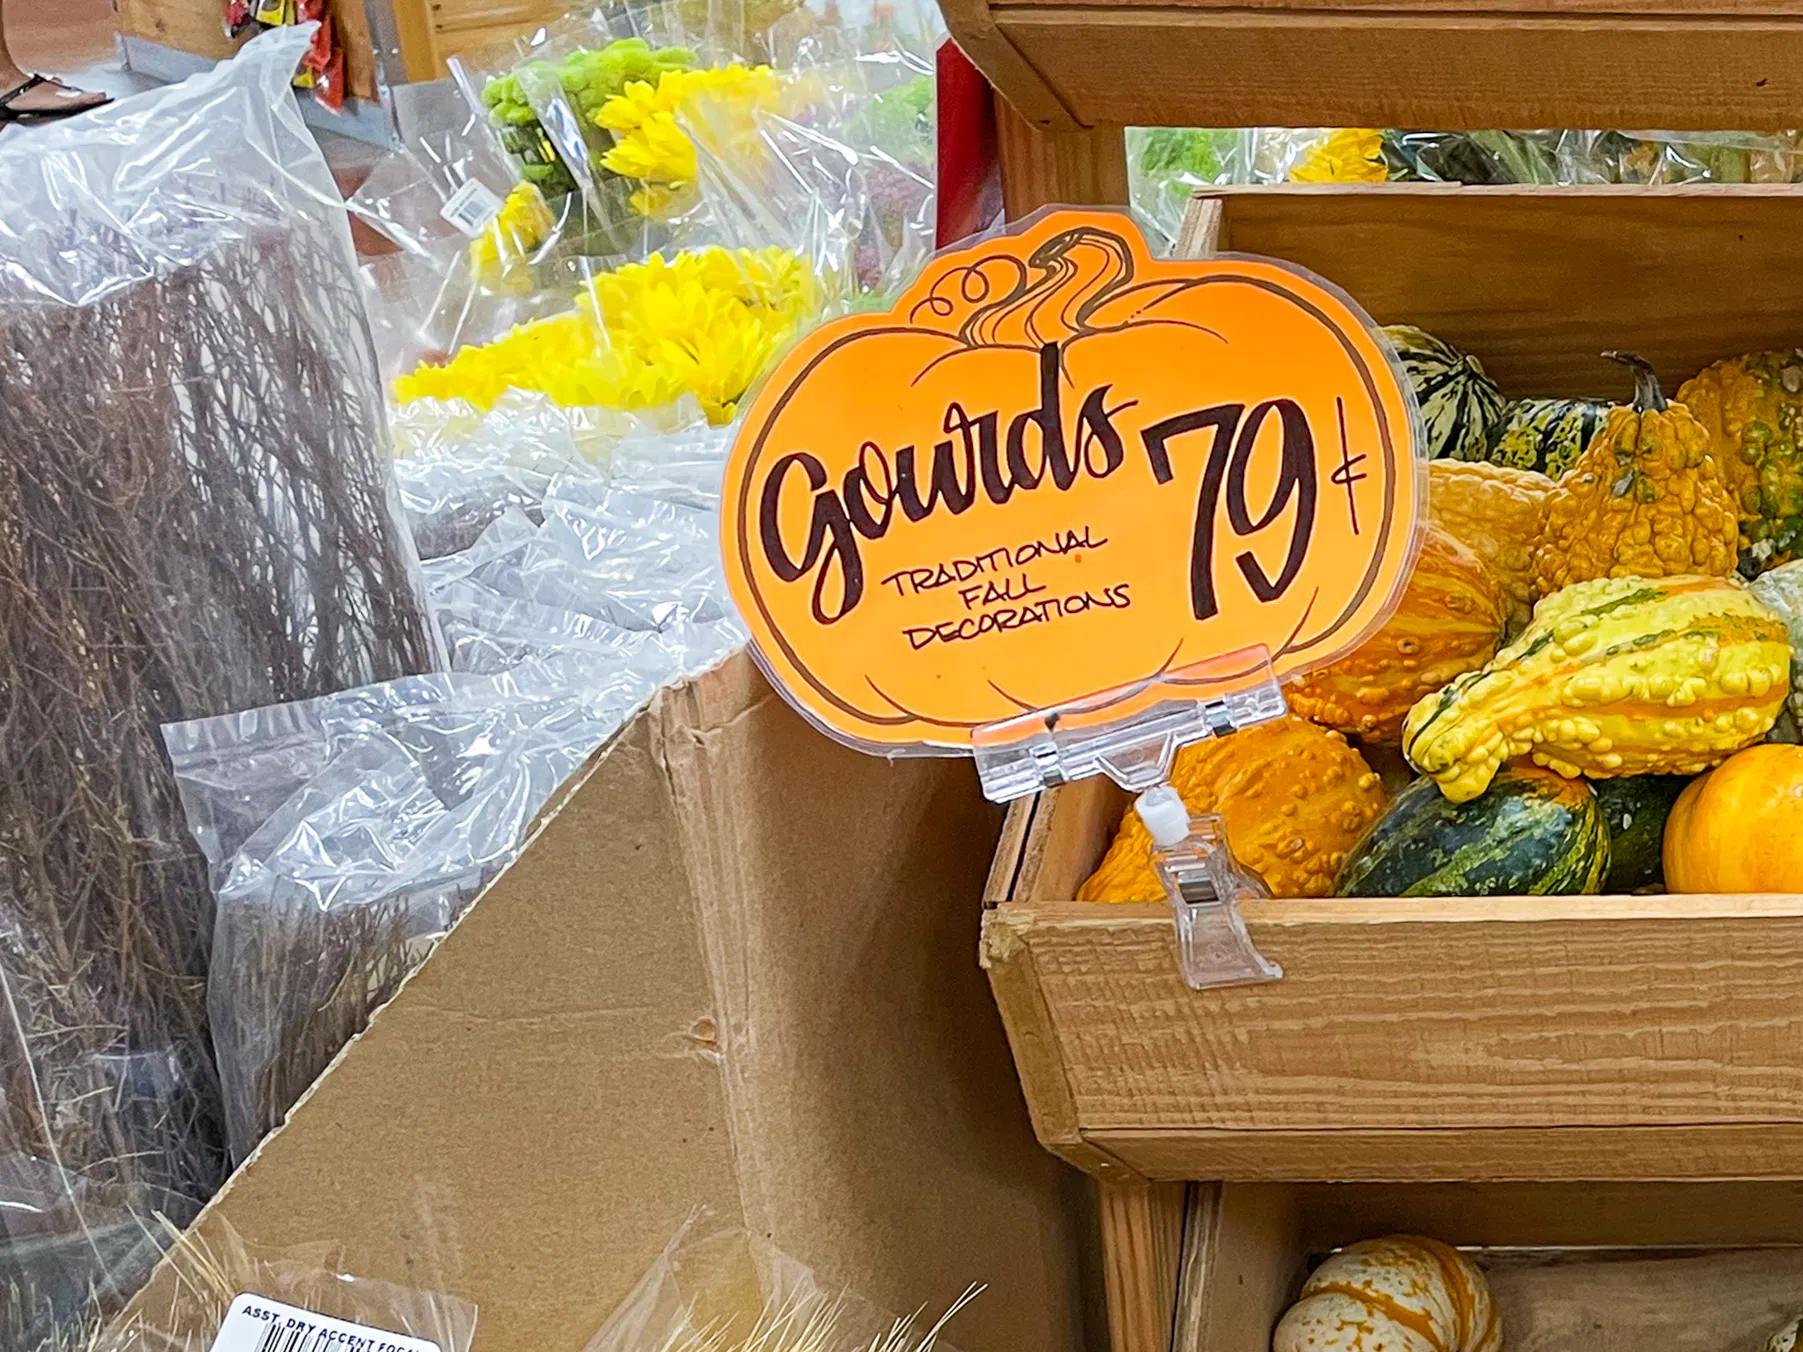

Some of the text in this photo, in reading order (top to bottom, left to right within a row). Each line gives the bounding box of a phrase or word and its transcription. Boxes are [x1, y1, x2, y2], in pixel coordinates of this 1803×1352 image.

[758, 340, 1139, 625] Gourds
[881, 525, 1109, 598] TRADITIONAL
[958, 575, 1047, 611] FALL
[902, 582, 1132, 651] DECORATIONS
[286, 1318, 316, 1334] DRY
[318, 1328, 376, 1349] ACCENT
